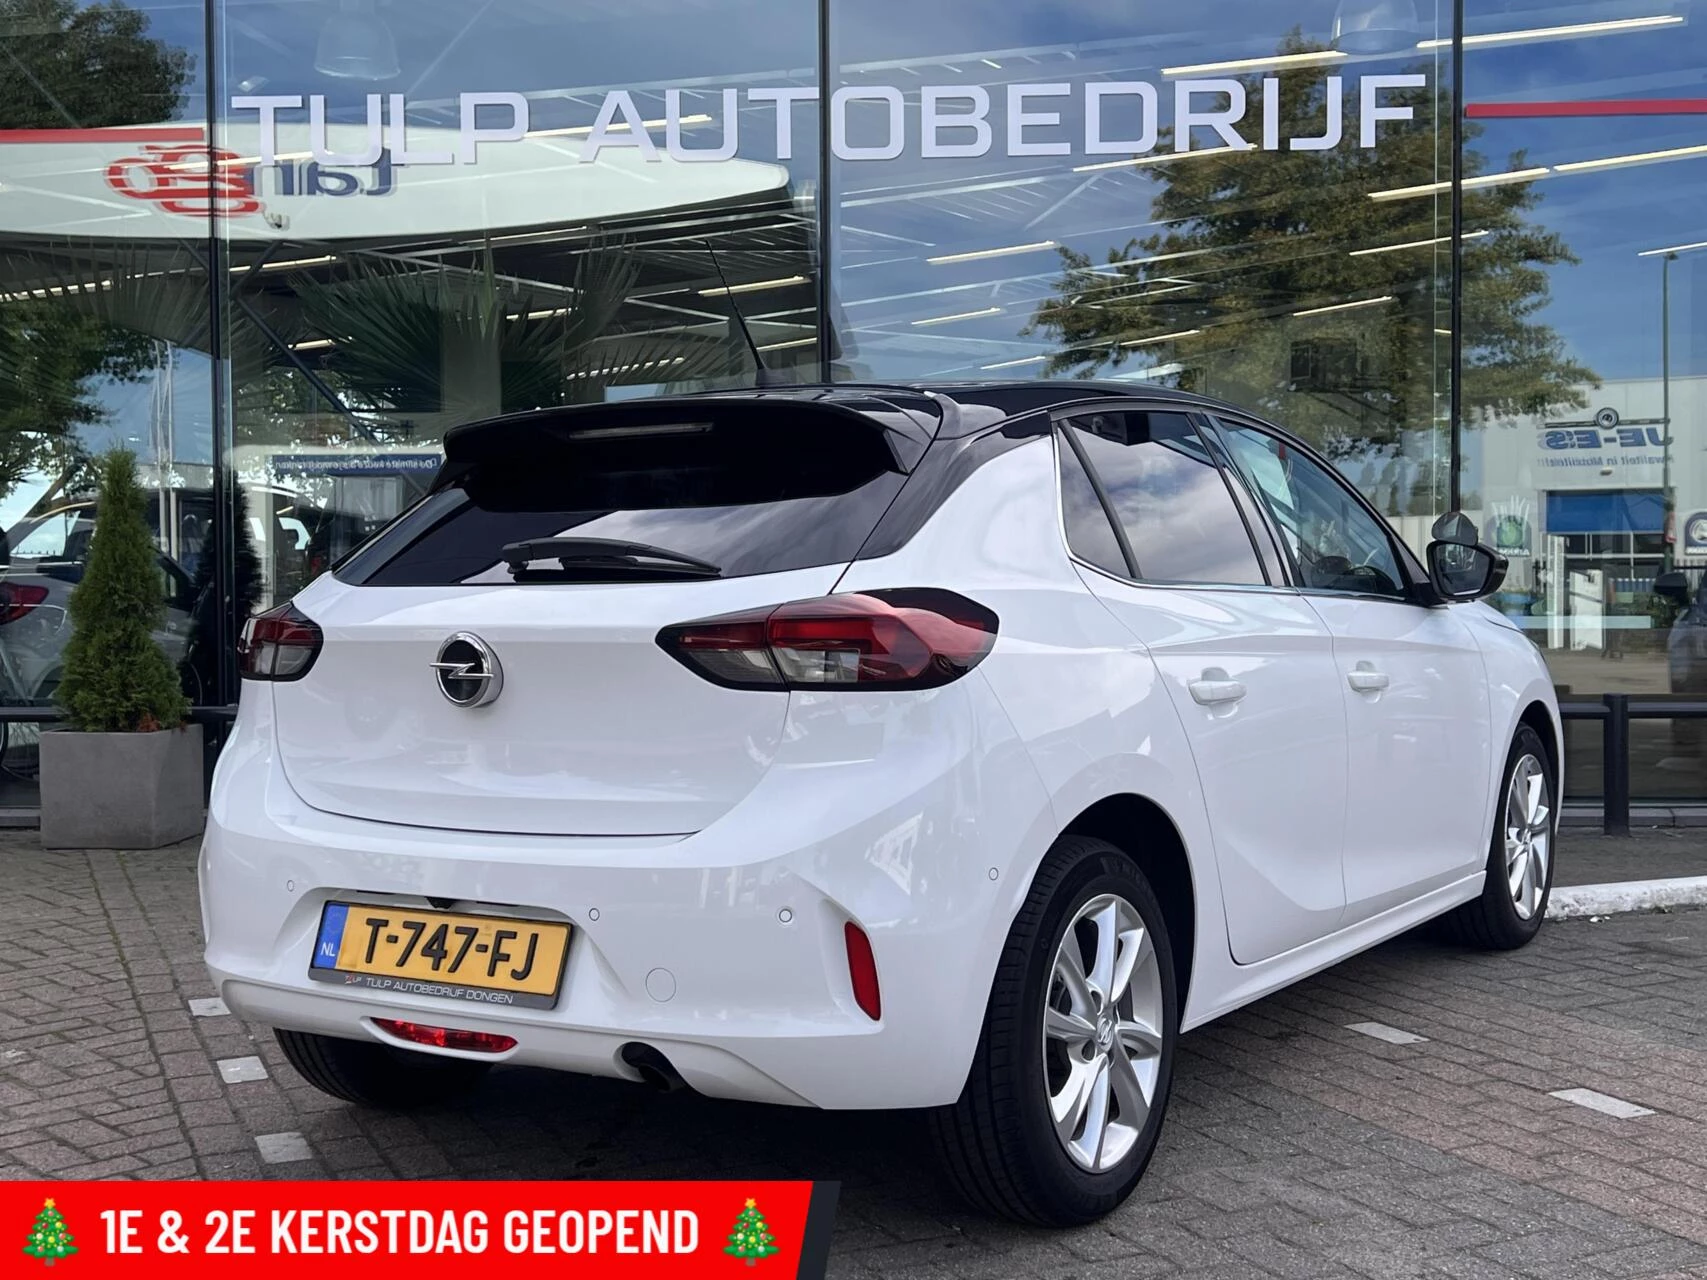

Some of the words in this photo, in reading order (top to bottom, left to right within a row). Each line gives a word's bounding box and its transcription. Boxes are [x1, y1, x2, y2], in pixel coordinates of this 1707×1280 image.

[231, 91, 530, 165] TULP
[579, 74, 1427, 164] AUTOBEDRIJF
[321, 942, 336, 957] NL
[365, 917, 539, 981] T-747-FJ
[366, 977, 392, 989] TULP
[393, 981, 464, 998] AUTOBEDRIJF
[466, 989, 513, 1004] DONGEN
